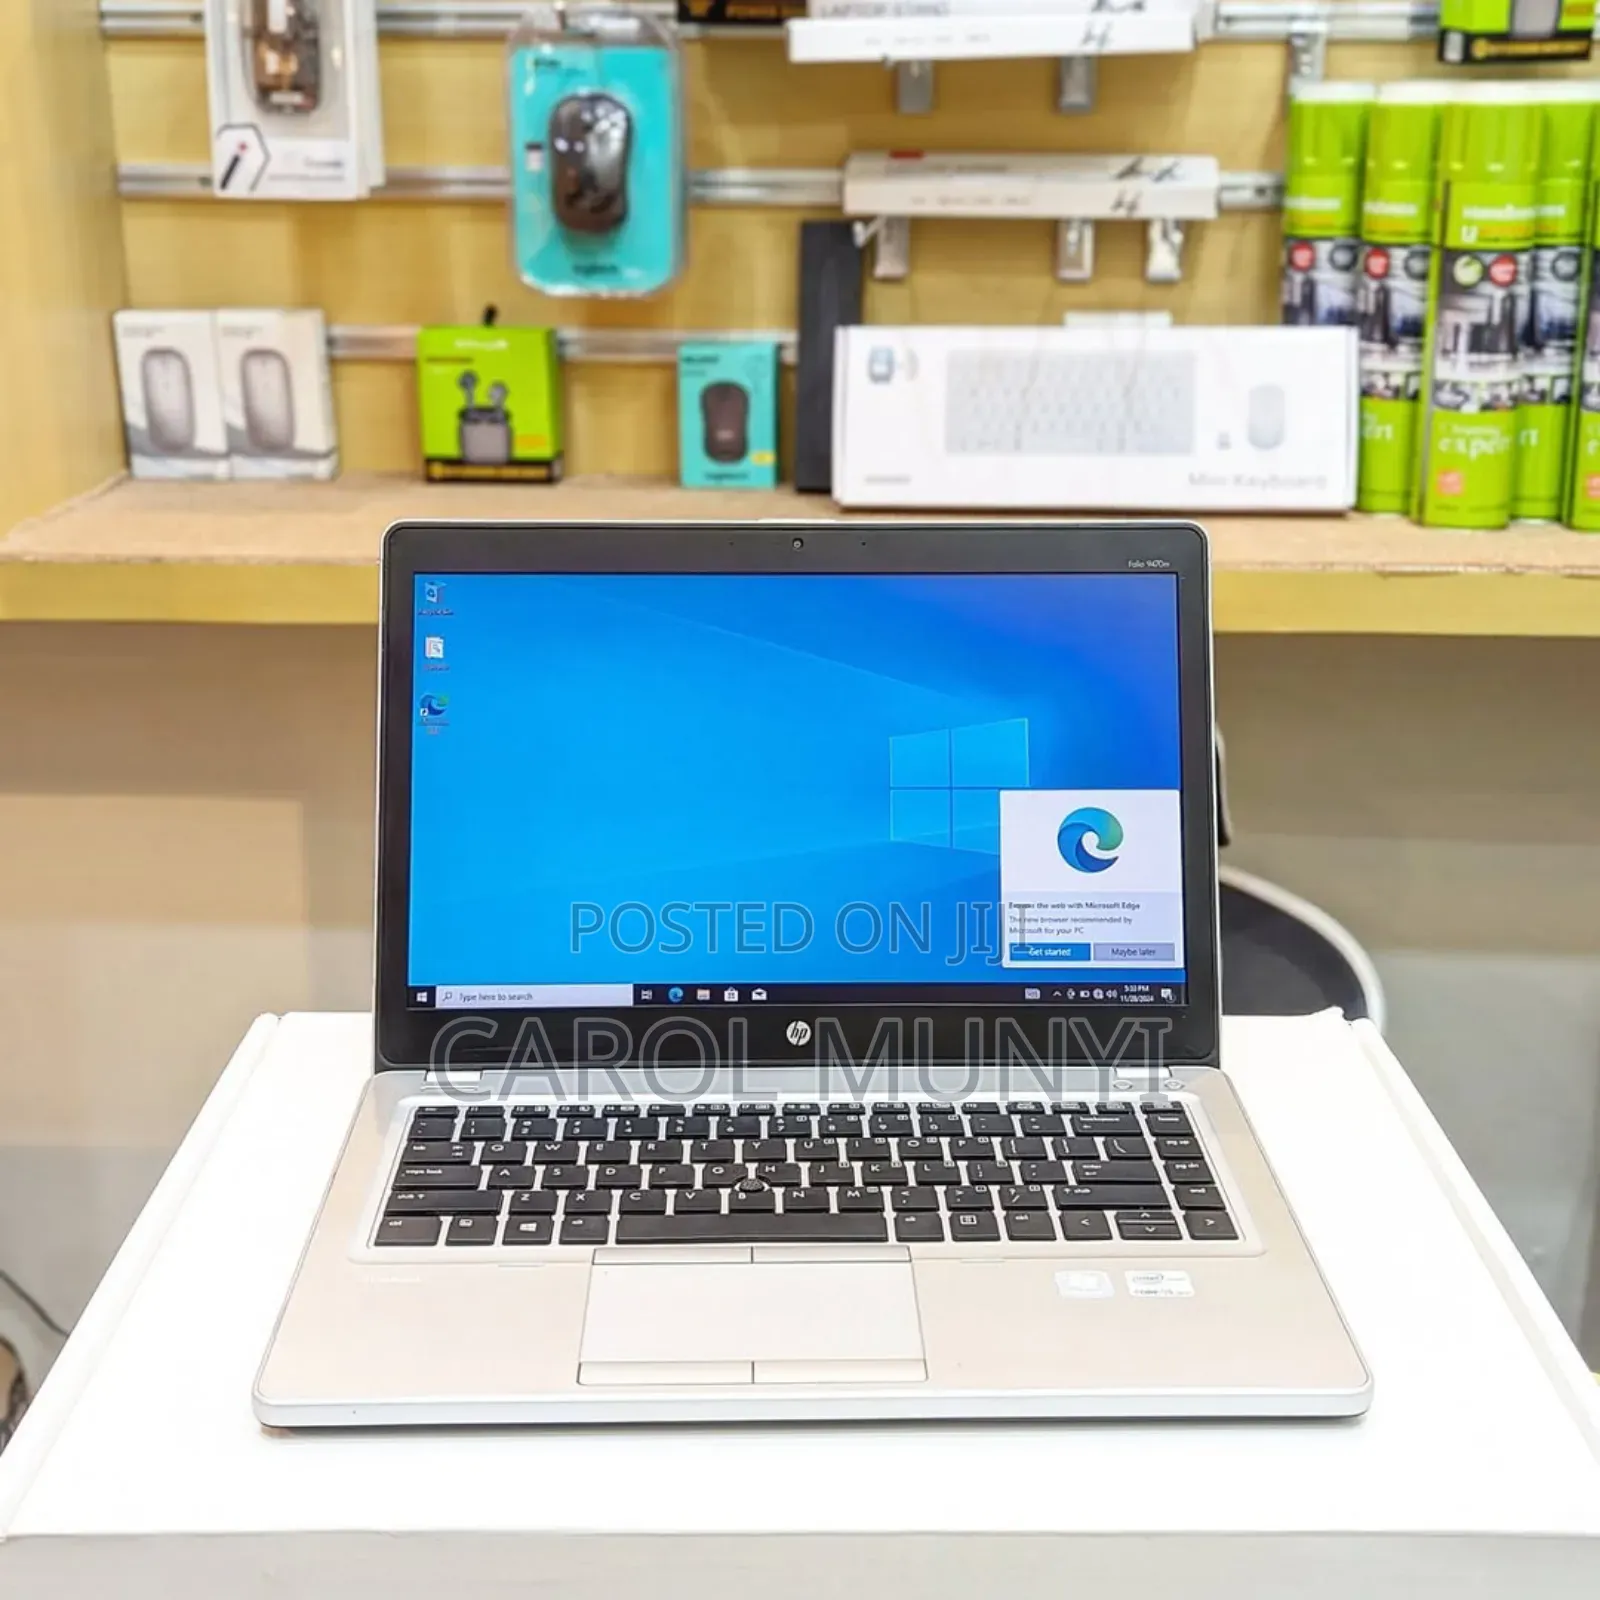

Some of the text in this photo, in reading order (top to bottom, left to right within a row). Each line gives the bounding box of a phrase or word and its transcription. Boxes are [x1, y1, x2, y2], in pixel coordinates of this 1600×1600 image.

[1121, 902, 1141, 911] Edge
[1070, 916, 1122, 924] recommended
[1044, 947, 1072, 956] started
[1111, 947, 1156, 958] Maybe later
[459, 992, 477, 1002] Type
[478, 992, 496, 1001] here
[508, 992, 533, 1001] search
[787, 1020, 811, 1046] hp
[544, 1143, 561, 1151] W
[595, 1143, 604, 1151] E
[700, 1142, 708, 1150] T
[752, 1141, 761, 1149] Y
[958, 1139, 966, 1147] P
[553, 1167, 561, 1176] S
[605, 1167, 616, 1176] D
[658, 1167, 666, 1175] F
[711, 1166, 725, 1174] G
[765, 1165, 776, 1173] H
[870, 1164, 880, 1172] K
[923, 1163, 931, 1172] L
[499, 1168, 511, 1176] A
[520, 1193, 530, 1201] Z
[575, 1193, 586, 1201] X
[629, 1192, 641, 1201] C
[685, 1191, 696, 1200] V
[792, 1190, 805, 1198] N
[846, 1190, 861, 1198] M
